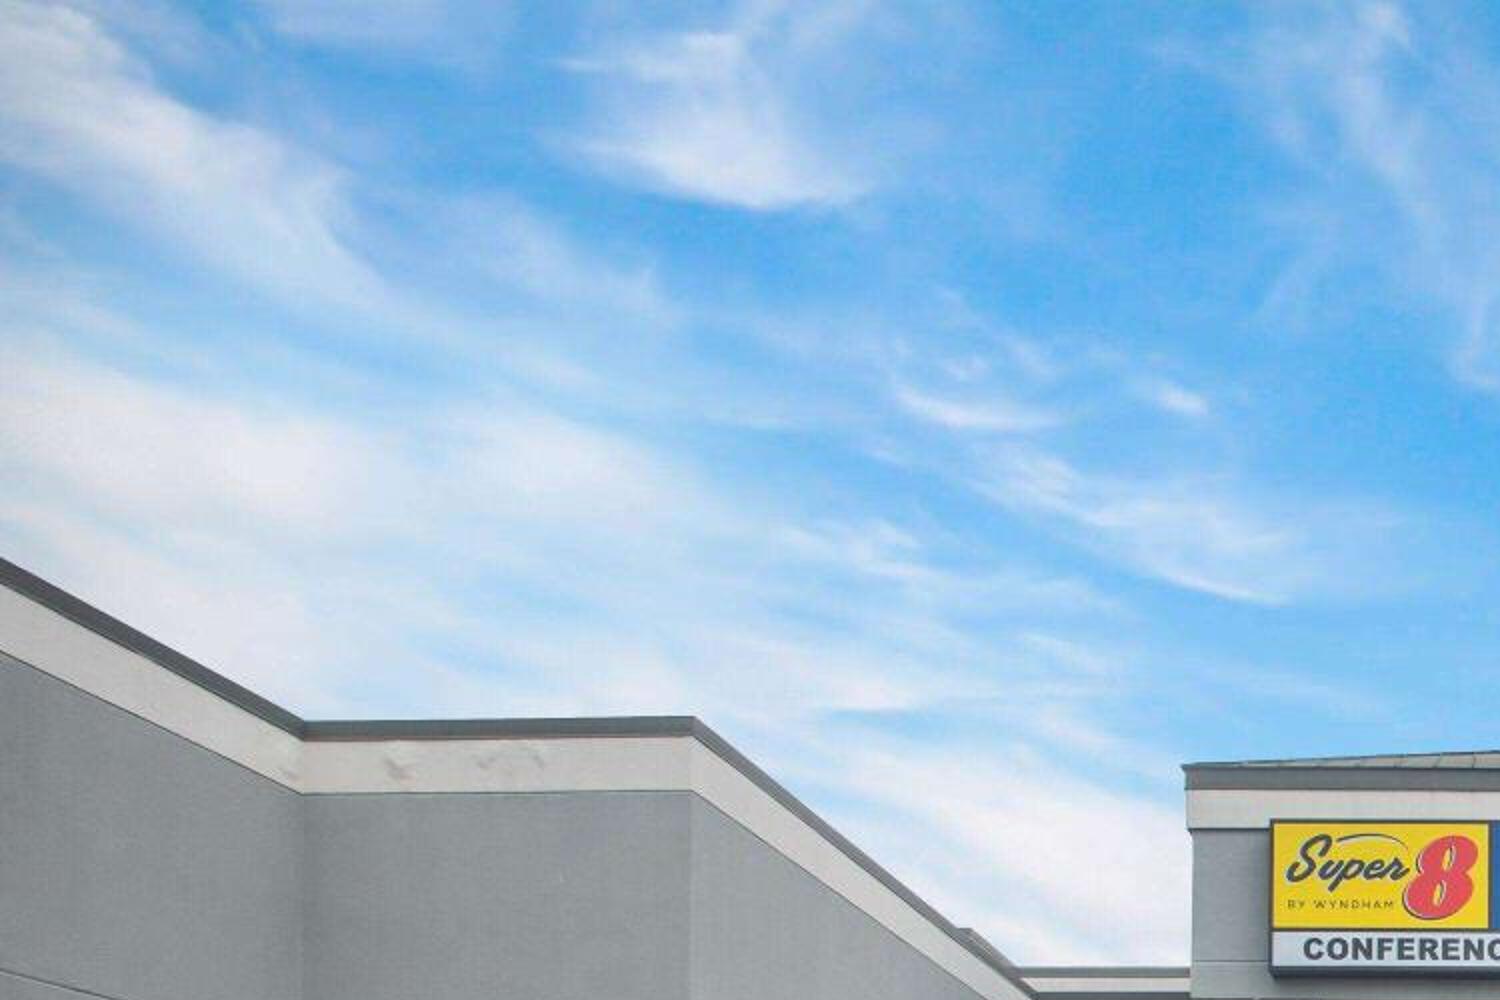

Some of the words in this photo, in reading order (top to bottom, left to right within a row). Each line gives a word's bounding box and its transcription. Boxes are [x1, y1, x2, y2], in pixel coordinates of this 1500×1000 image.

[1286, 833, 1410, 893] Super
[1402, 835, 1479, 921] 8
[1287, 899, 1306, 909] BY
[1313, 899, 1395, 909] WYNDHAM
